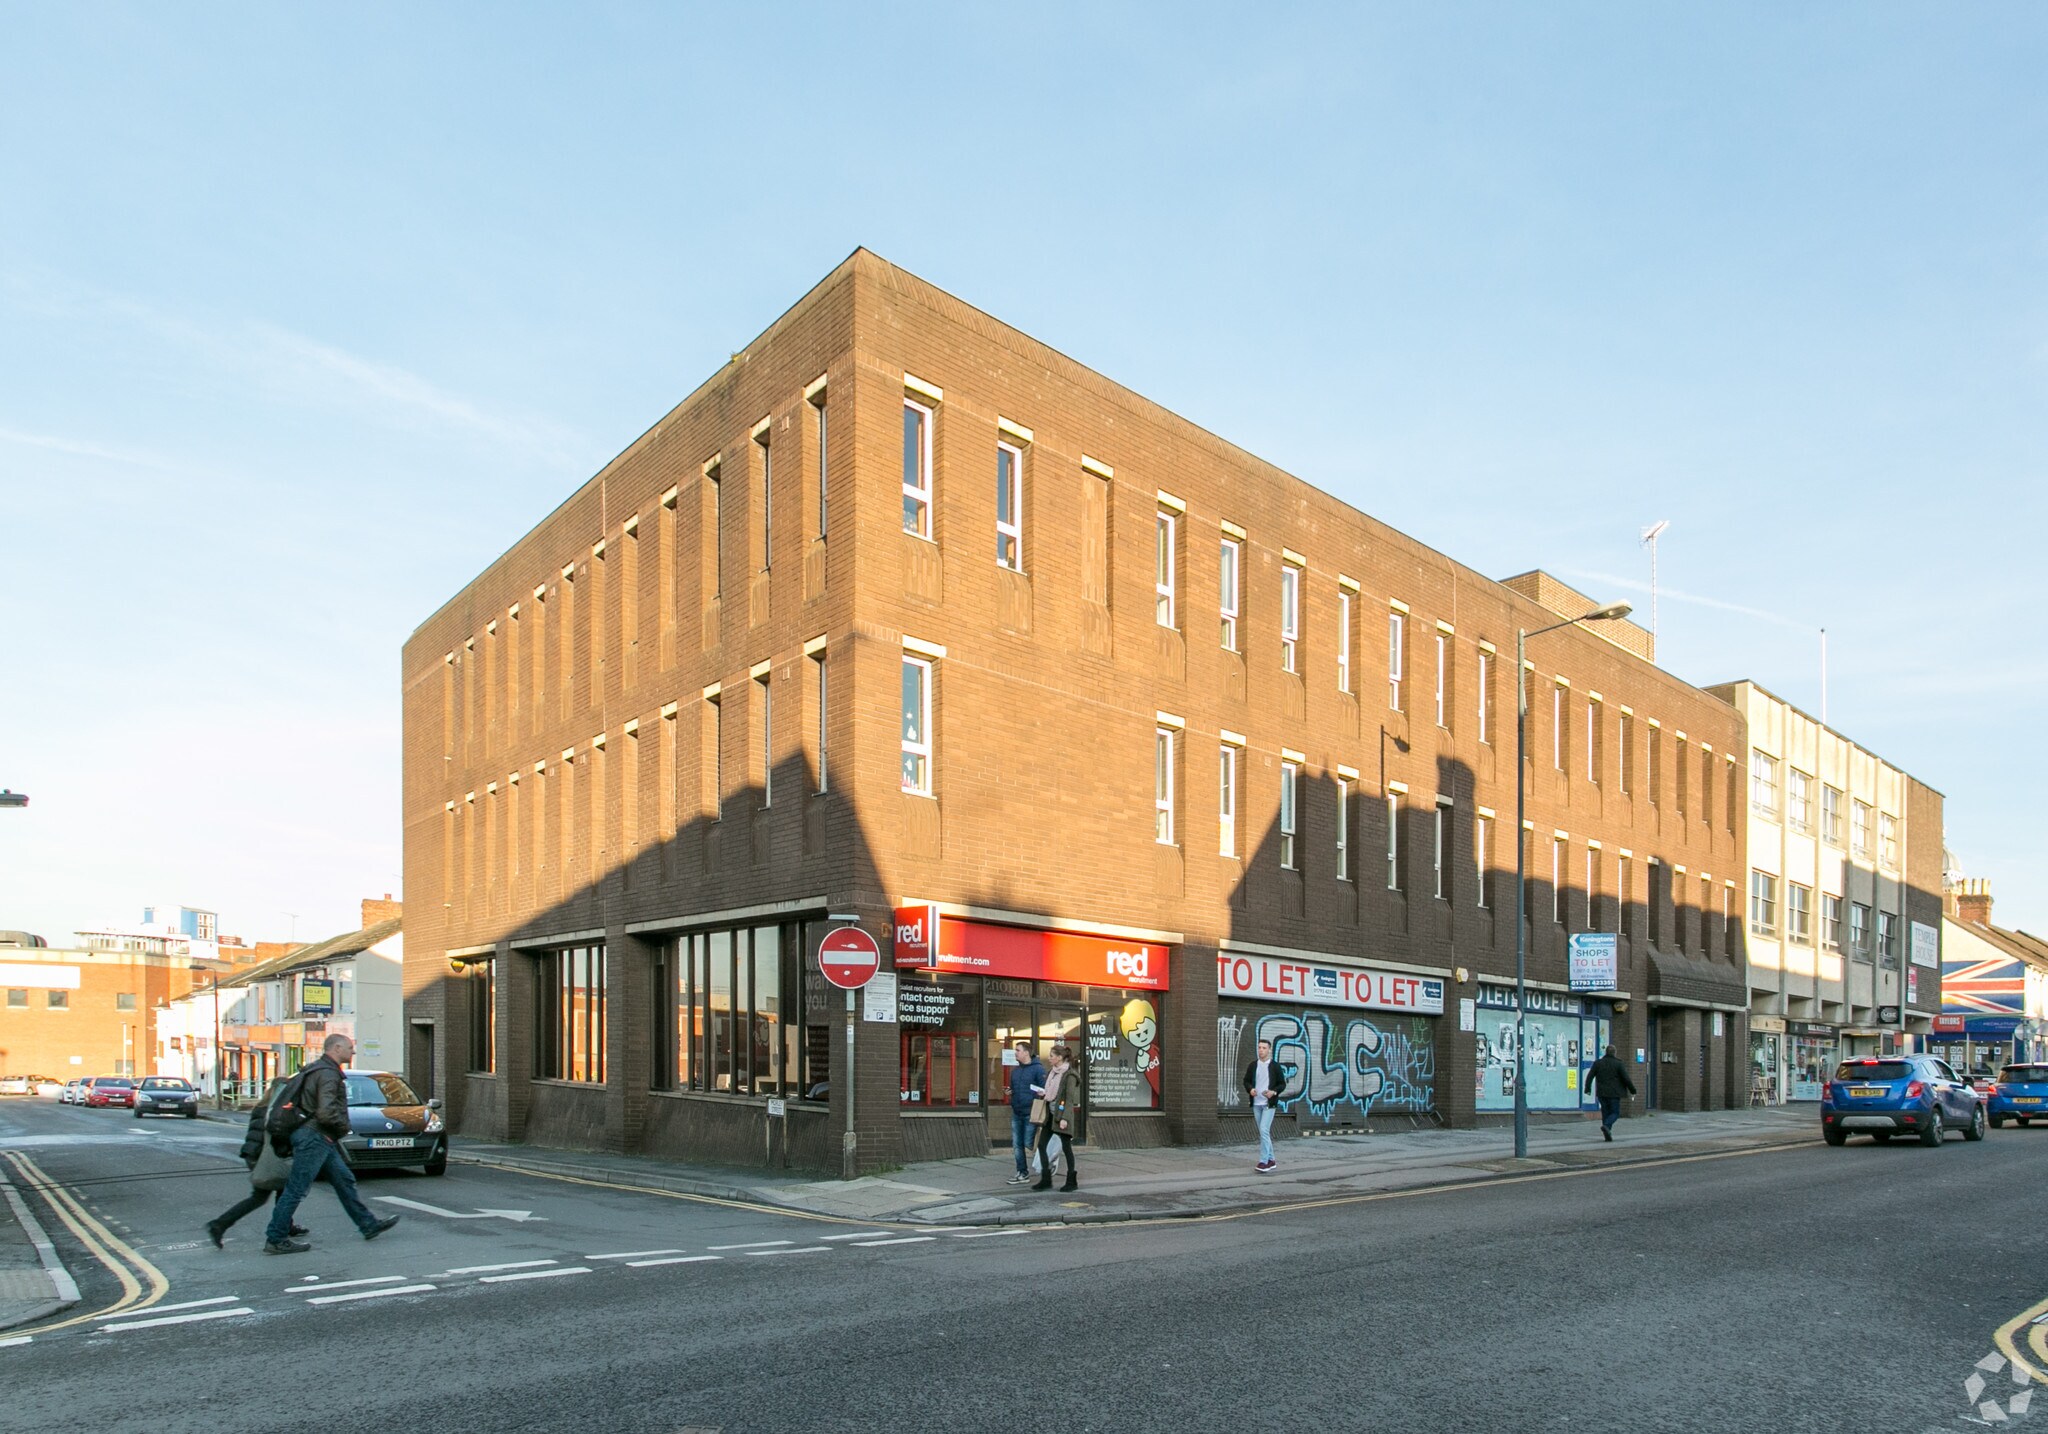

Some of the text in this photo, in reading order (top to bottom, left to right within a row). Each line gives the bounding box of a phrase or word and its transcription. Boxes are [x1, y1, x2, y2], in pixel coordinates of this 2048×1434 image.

[897, 918, 922, 943] red
[1915, 928, 1935, 945] TEMPLE
[938, 953, 990, 966] ruitment.com
[1576, 949, 1609, 957] SHOPS
[1916, 946, 1934, 962] HOUSE
[1107, 947, 1148, 977] red
[1575, 959, 1610, 967] TO LET
[1128, 976, 1158, 985] recruitment
[1216, 957, 1310, 996] TO LET
[1340, 971, 1419, 1007] TO LET
[1487, 985, 1510, 1006] LET
[900, 993, 955, 1004] ntact centres
[1525, 990, 1542, 1009] TO
[1545, 992, 1566, 1011] LET
[916, 1004, 949, 1015] support
[900, 1014, 944, 1026] countancy
[1939, 1017, 1960, 1025] TAYLORS
[1089, 1024, 1106, 1034] we
[1089, 1036, 1117, 1048] want
[1089, 1049, 1111, 1063] you
